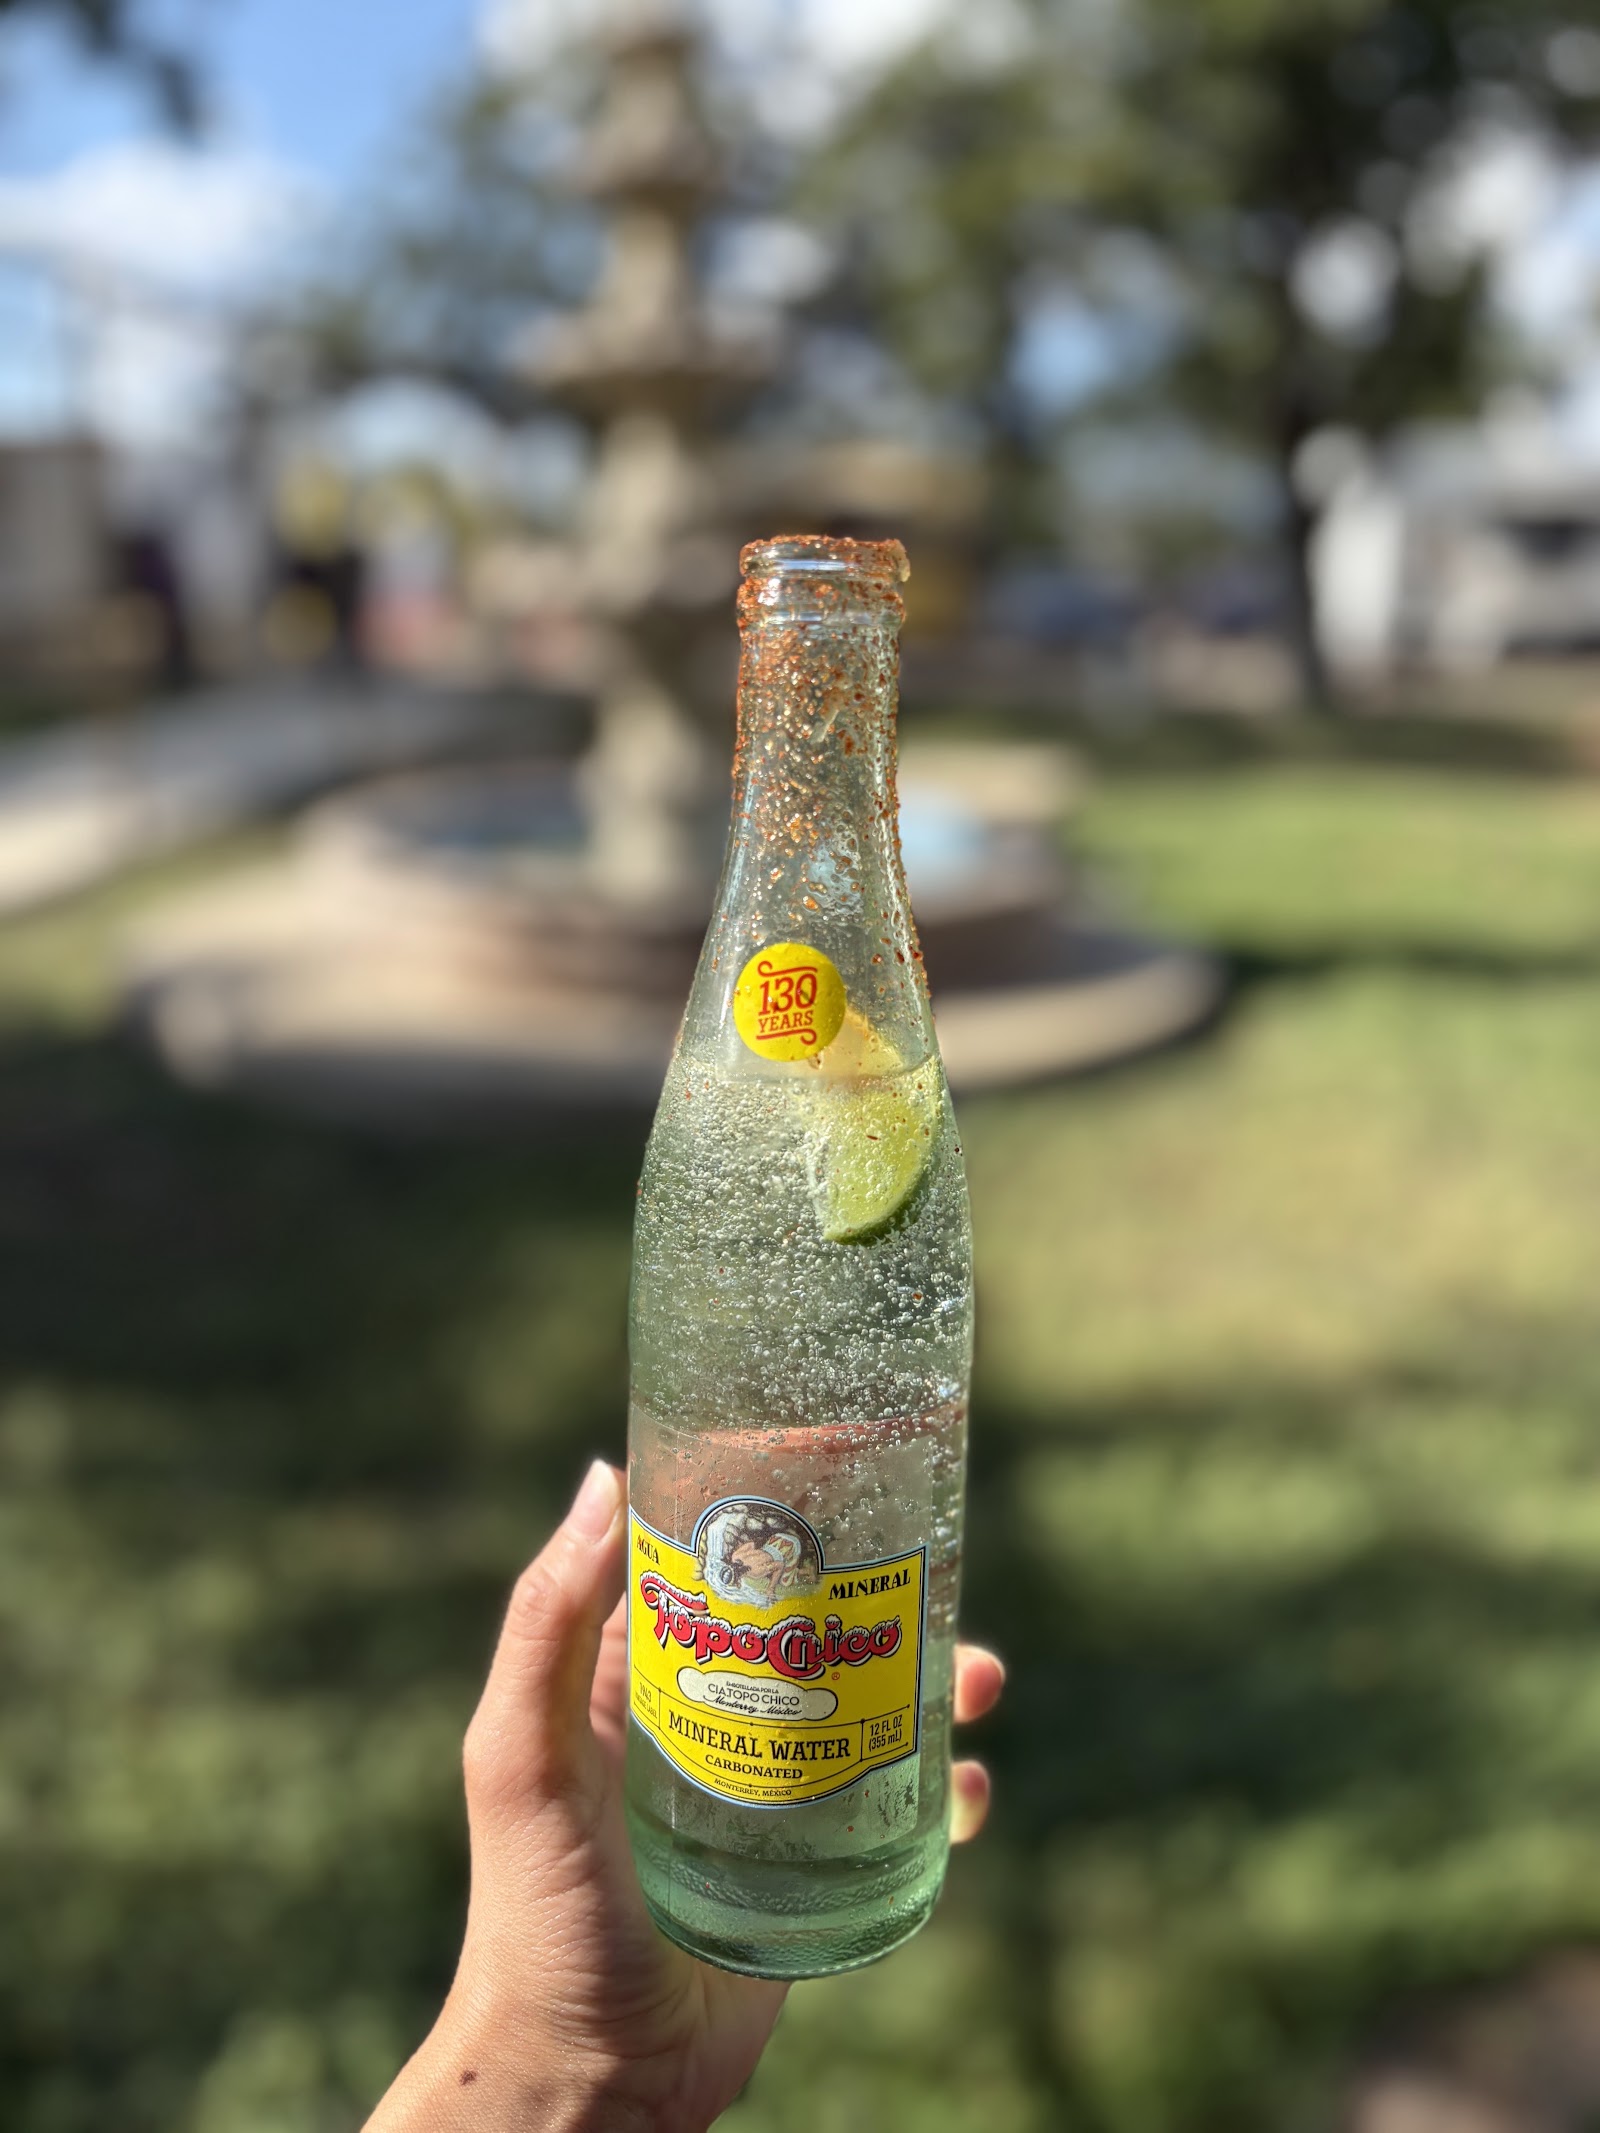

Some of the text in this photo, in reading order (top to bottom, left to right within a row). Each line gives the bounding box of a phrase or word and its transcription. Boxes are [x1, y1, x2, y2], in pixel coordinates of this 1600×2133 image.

[758, 973, 818, 1016] 130
[758, 1010, 814, 1033] YEARS
[636, 1534, 660, 1566] AGUA
[828, 1568, 911, 1600] MINERAL
[640, 1569, 903, 1680] Topo Chico
[703, 1695, 759, 1714] Monterrey
[761, 1694, 800, 1706] CHICO
[668, 1709, 851, 1761] MINERAL WATER
[870, 1714, 903, 1737] 12 FL OZ
[869, 1728, 902, 1752] (355 mL)
[705, 1754, 803, 1779] CARBONATED
[714, 1778, 760, 1797] MONTERREY,
